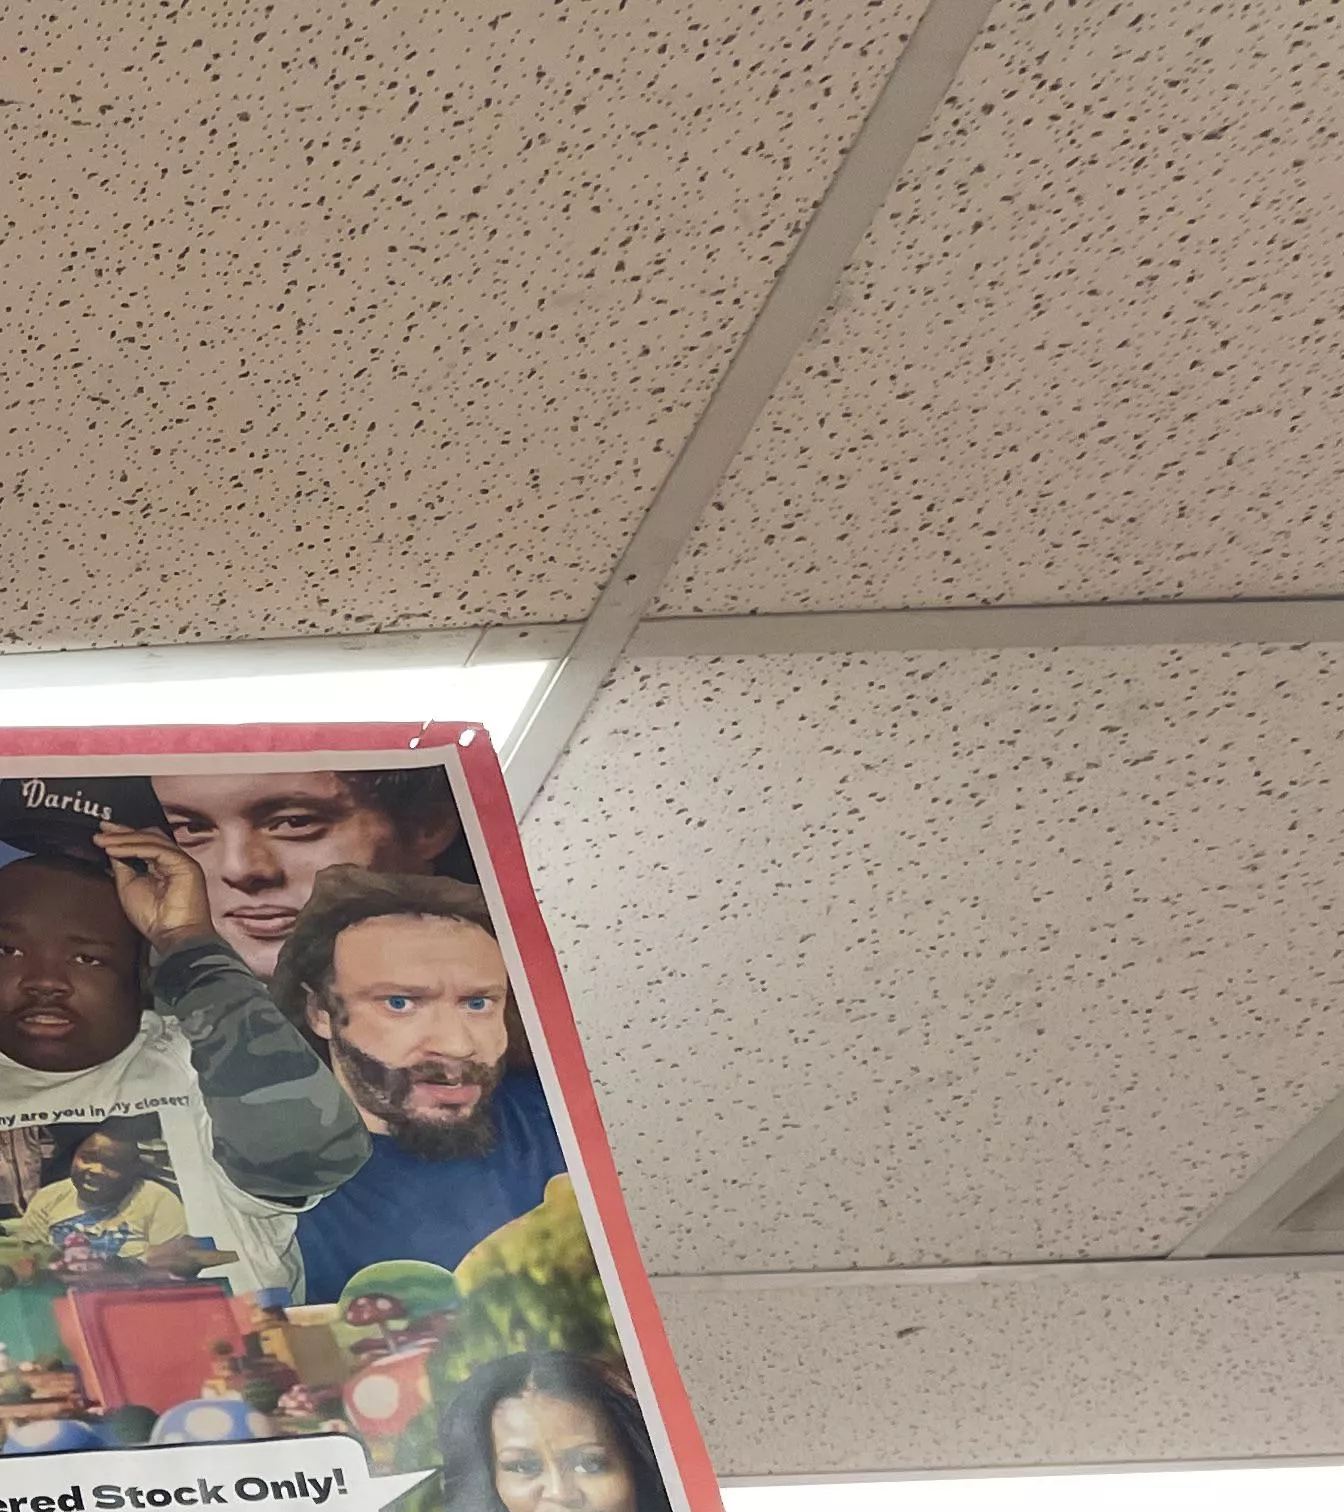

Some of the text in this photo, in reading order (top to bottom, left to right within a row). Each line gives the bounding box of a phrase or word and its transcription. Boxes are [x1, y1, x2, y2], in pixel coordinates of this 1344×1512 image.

[20, 778, 113, 821] Darius
[20, 1110, 49, 1123] are
[52, 1107, 86, 1124] you
[90, 1104, 105, 1118] in
[92, 1476, 226, 1511] Stock
[233, 1467, 349, 1506] Only!
